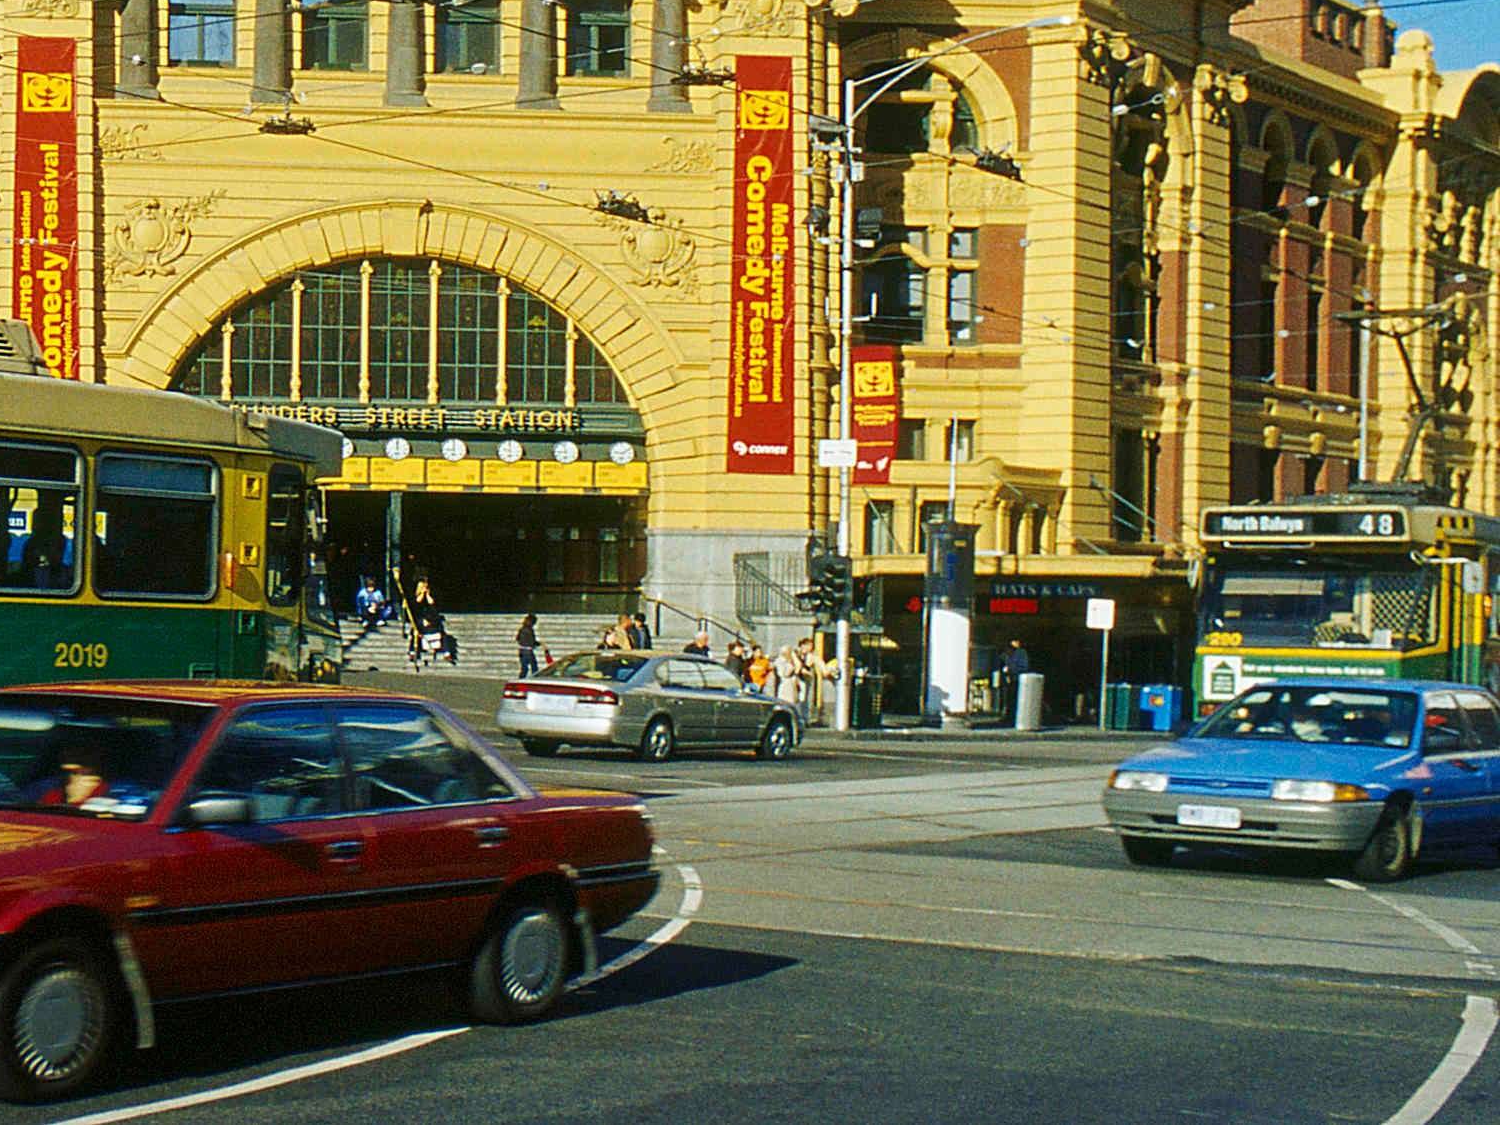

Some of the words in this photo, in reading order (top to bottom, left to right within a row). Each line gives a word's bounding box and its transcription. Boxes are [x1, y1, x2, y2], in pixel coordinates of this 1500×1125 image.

[38, 143, 59, 246] Festival
[740, 156, 772, 295] Comedy
[771, 203, 789, 318] Melbourne
[748, 302, 769, 402] Festival
[772, 323, 783, 402] International
[366, 407, 447, 425] STREET
[475, 409, 573, 427] STATION
[994, 584, 1037, 596] HATS
[54, 642, 108, 668] 2019
